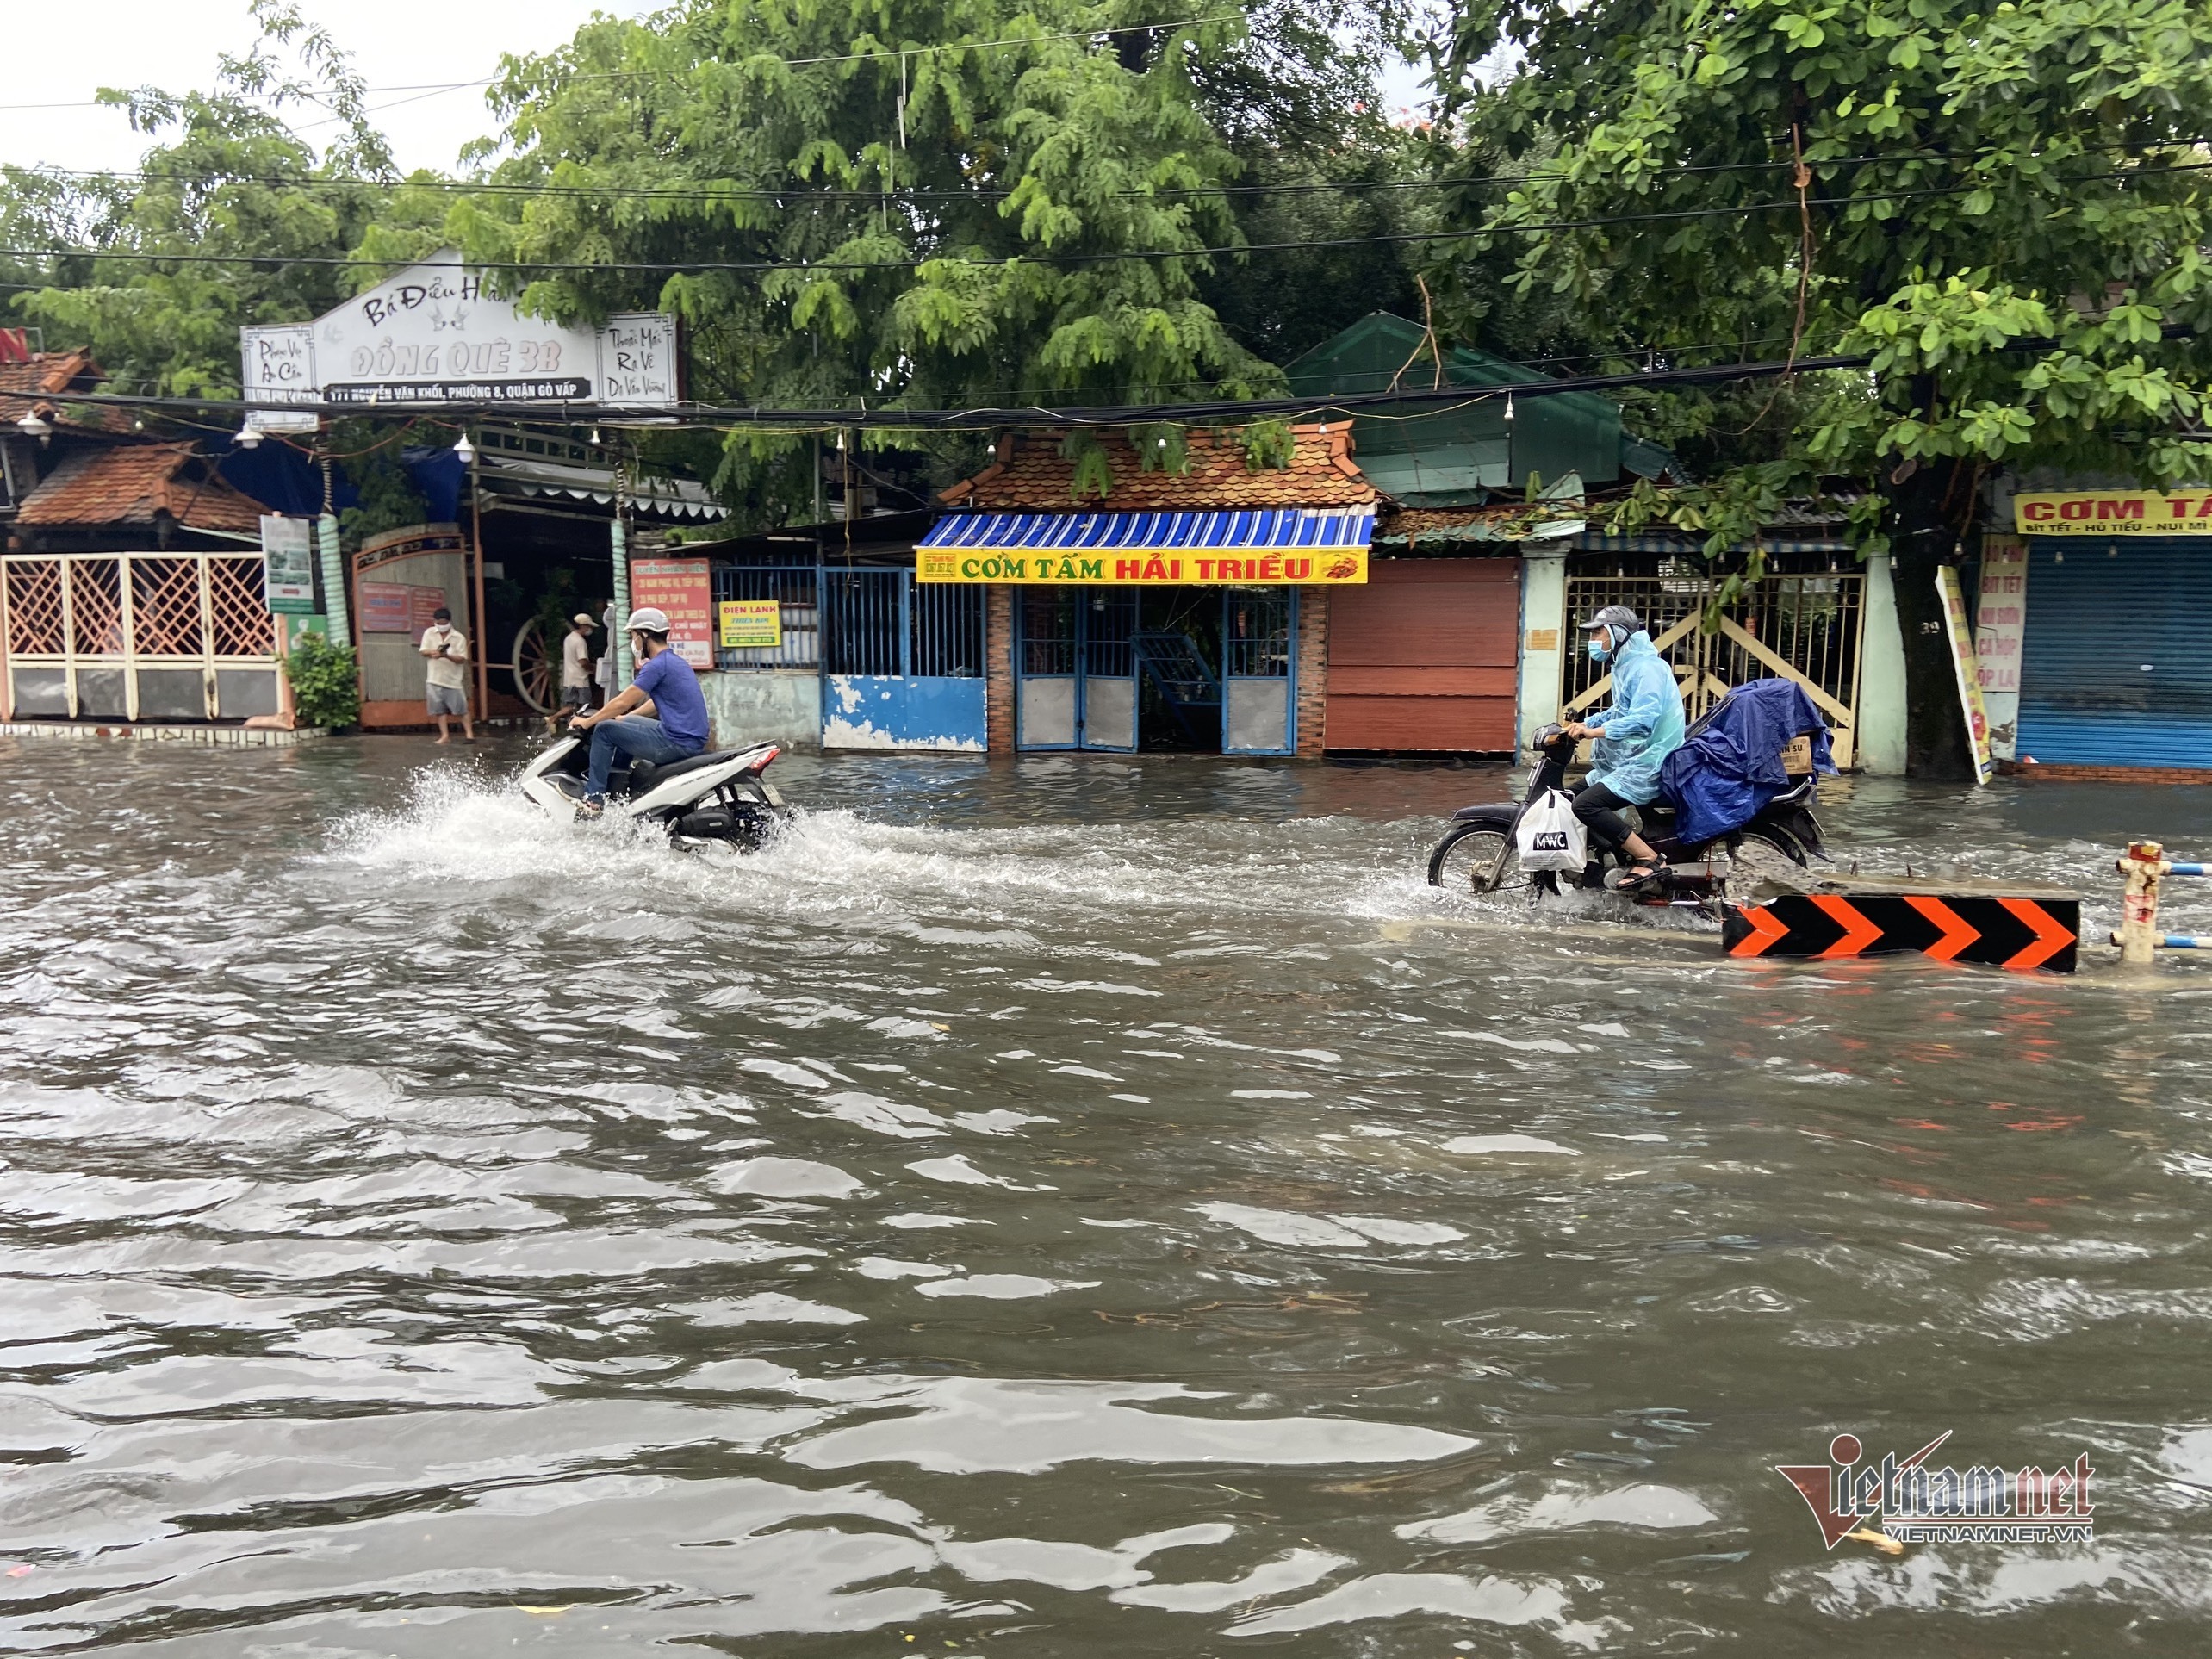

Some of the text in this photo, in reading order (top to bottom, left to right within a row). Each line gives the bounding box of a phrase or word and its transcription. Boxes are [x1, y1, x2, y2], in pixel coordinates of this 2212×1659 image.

[350, 335, 562, 377] ĐỒNG QUÊ 3B
[449, 384, 492, 399] PHƯỜNG
[506, 385, 536, 400] QUẬN
[537, 385, 554, 397] GÒ
[556, 380, 577, 397] VẤP
[2023, 499, 2145, 521] CƠM
[2050, 521, 2072, 532] TẾT
[2110, 520, 2141, 531] TIẾU
[961, 551, 1310, 580] CƠM TẤM HẢI TRIỀU
[1779, 744, 1803, 754] IN-SU
[1536, 833, 1566, 848] MWC
